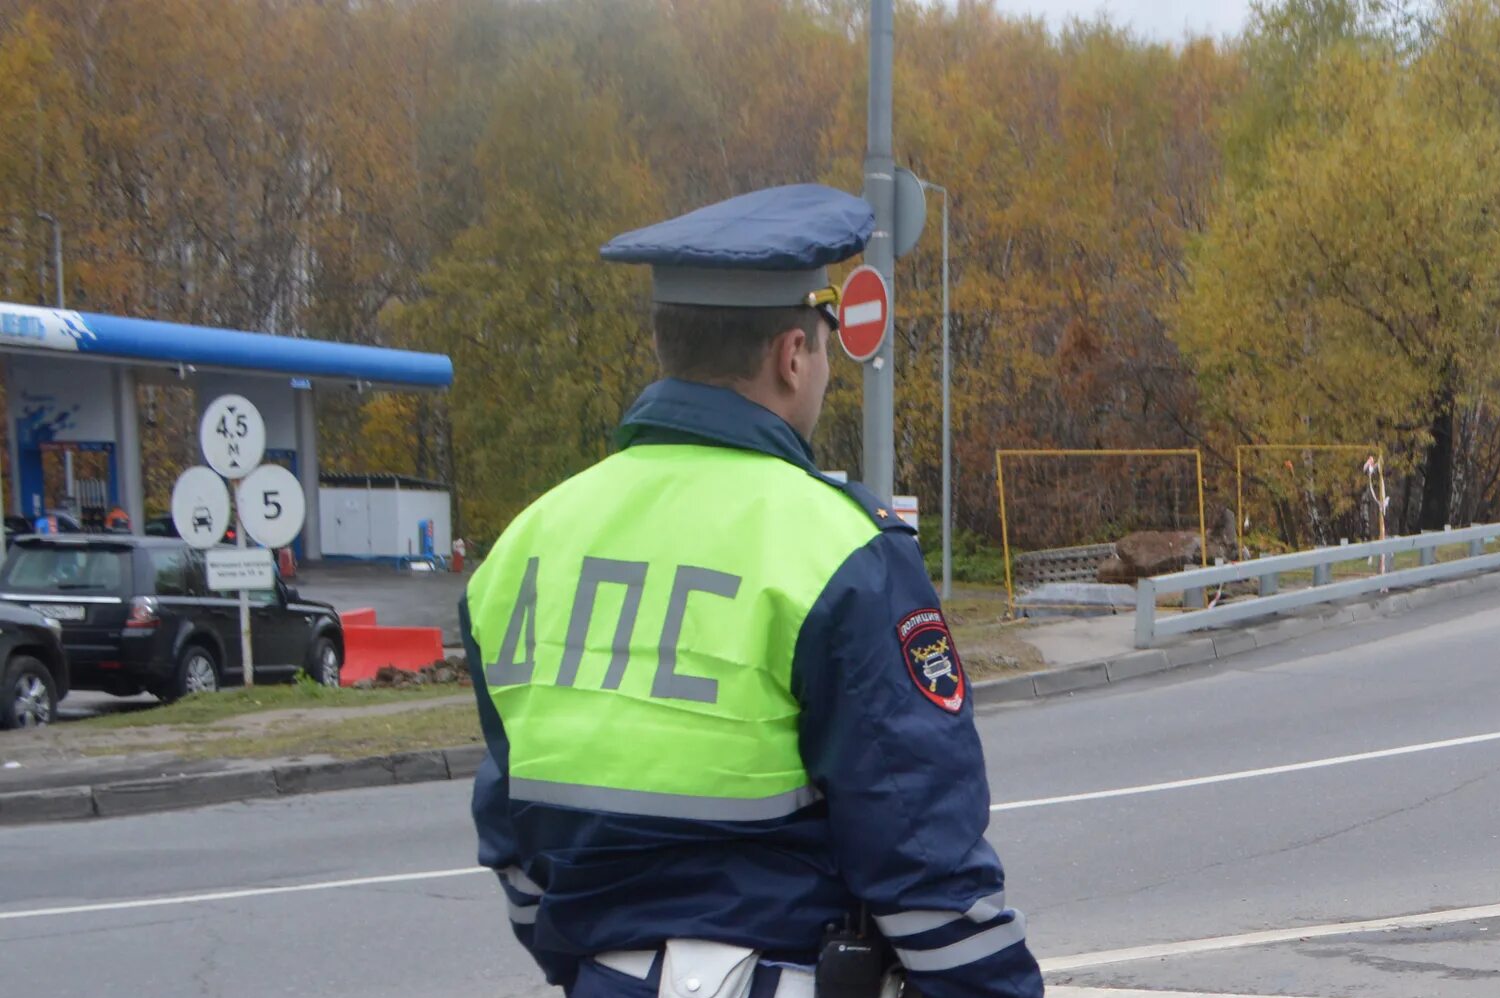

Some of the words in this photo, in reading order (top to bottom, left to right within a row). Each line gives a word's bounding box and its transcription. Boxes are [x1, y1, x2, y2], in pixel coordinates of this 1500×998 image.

[262, 491, 282, 520] 5
[485, 556, 743, 704] ДПС
[901, 612, 940, 637] ПОЛИЦИЯ
